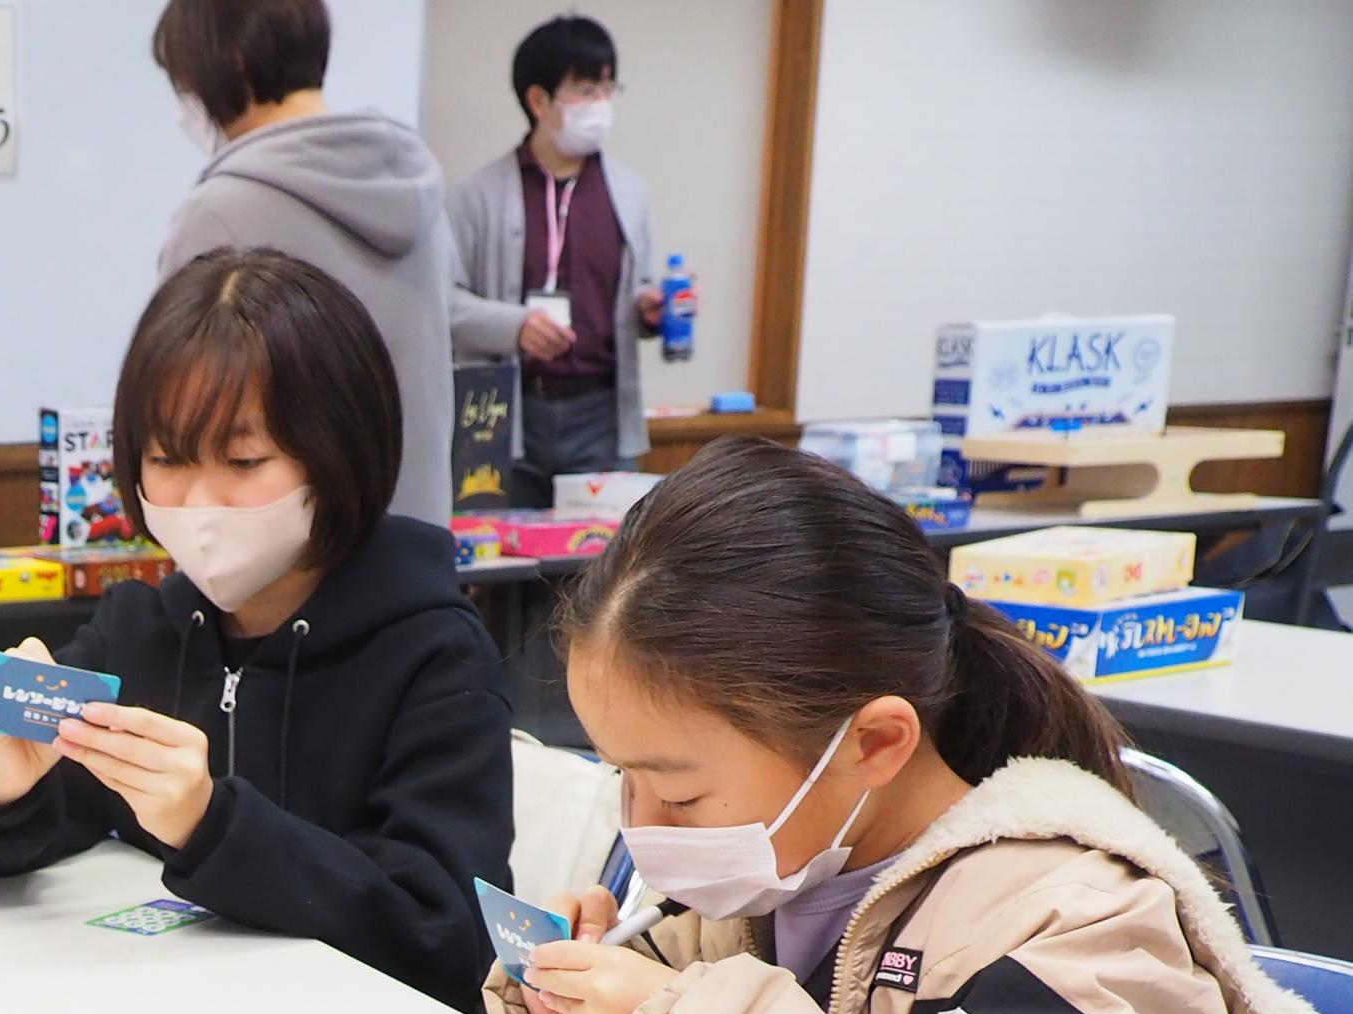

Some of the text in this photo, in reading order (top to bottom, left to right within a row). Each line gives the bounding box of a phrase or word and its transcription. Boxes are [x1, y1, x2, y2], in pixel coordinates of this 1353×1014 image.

[1028, 330, 1125, 374] KLASK
[2, 685, 88, 714] レンソービン
